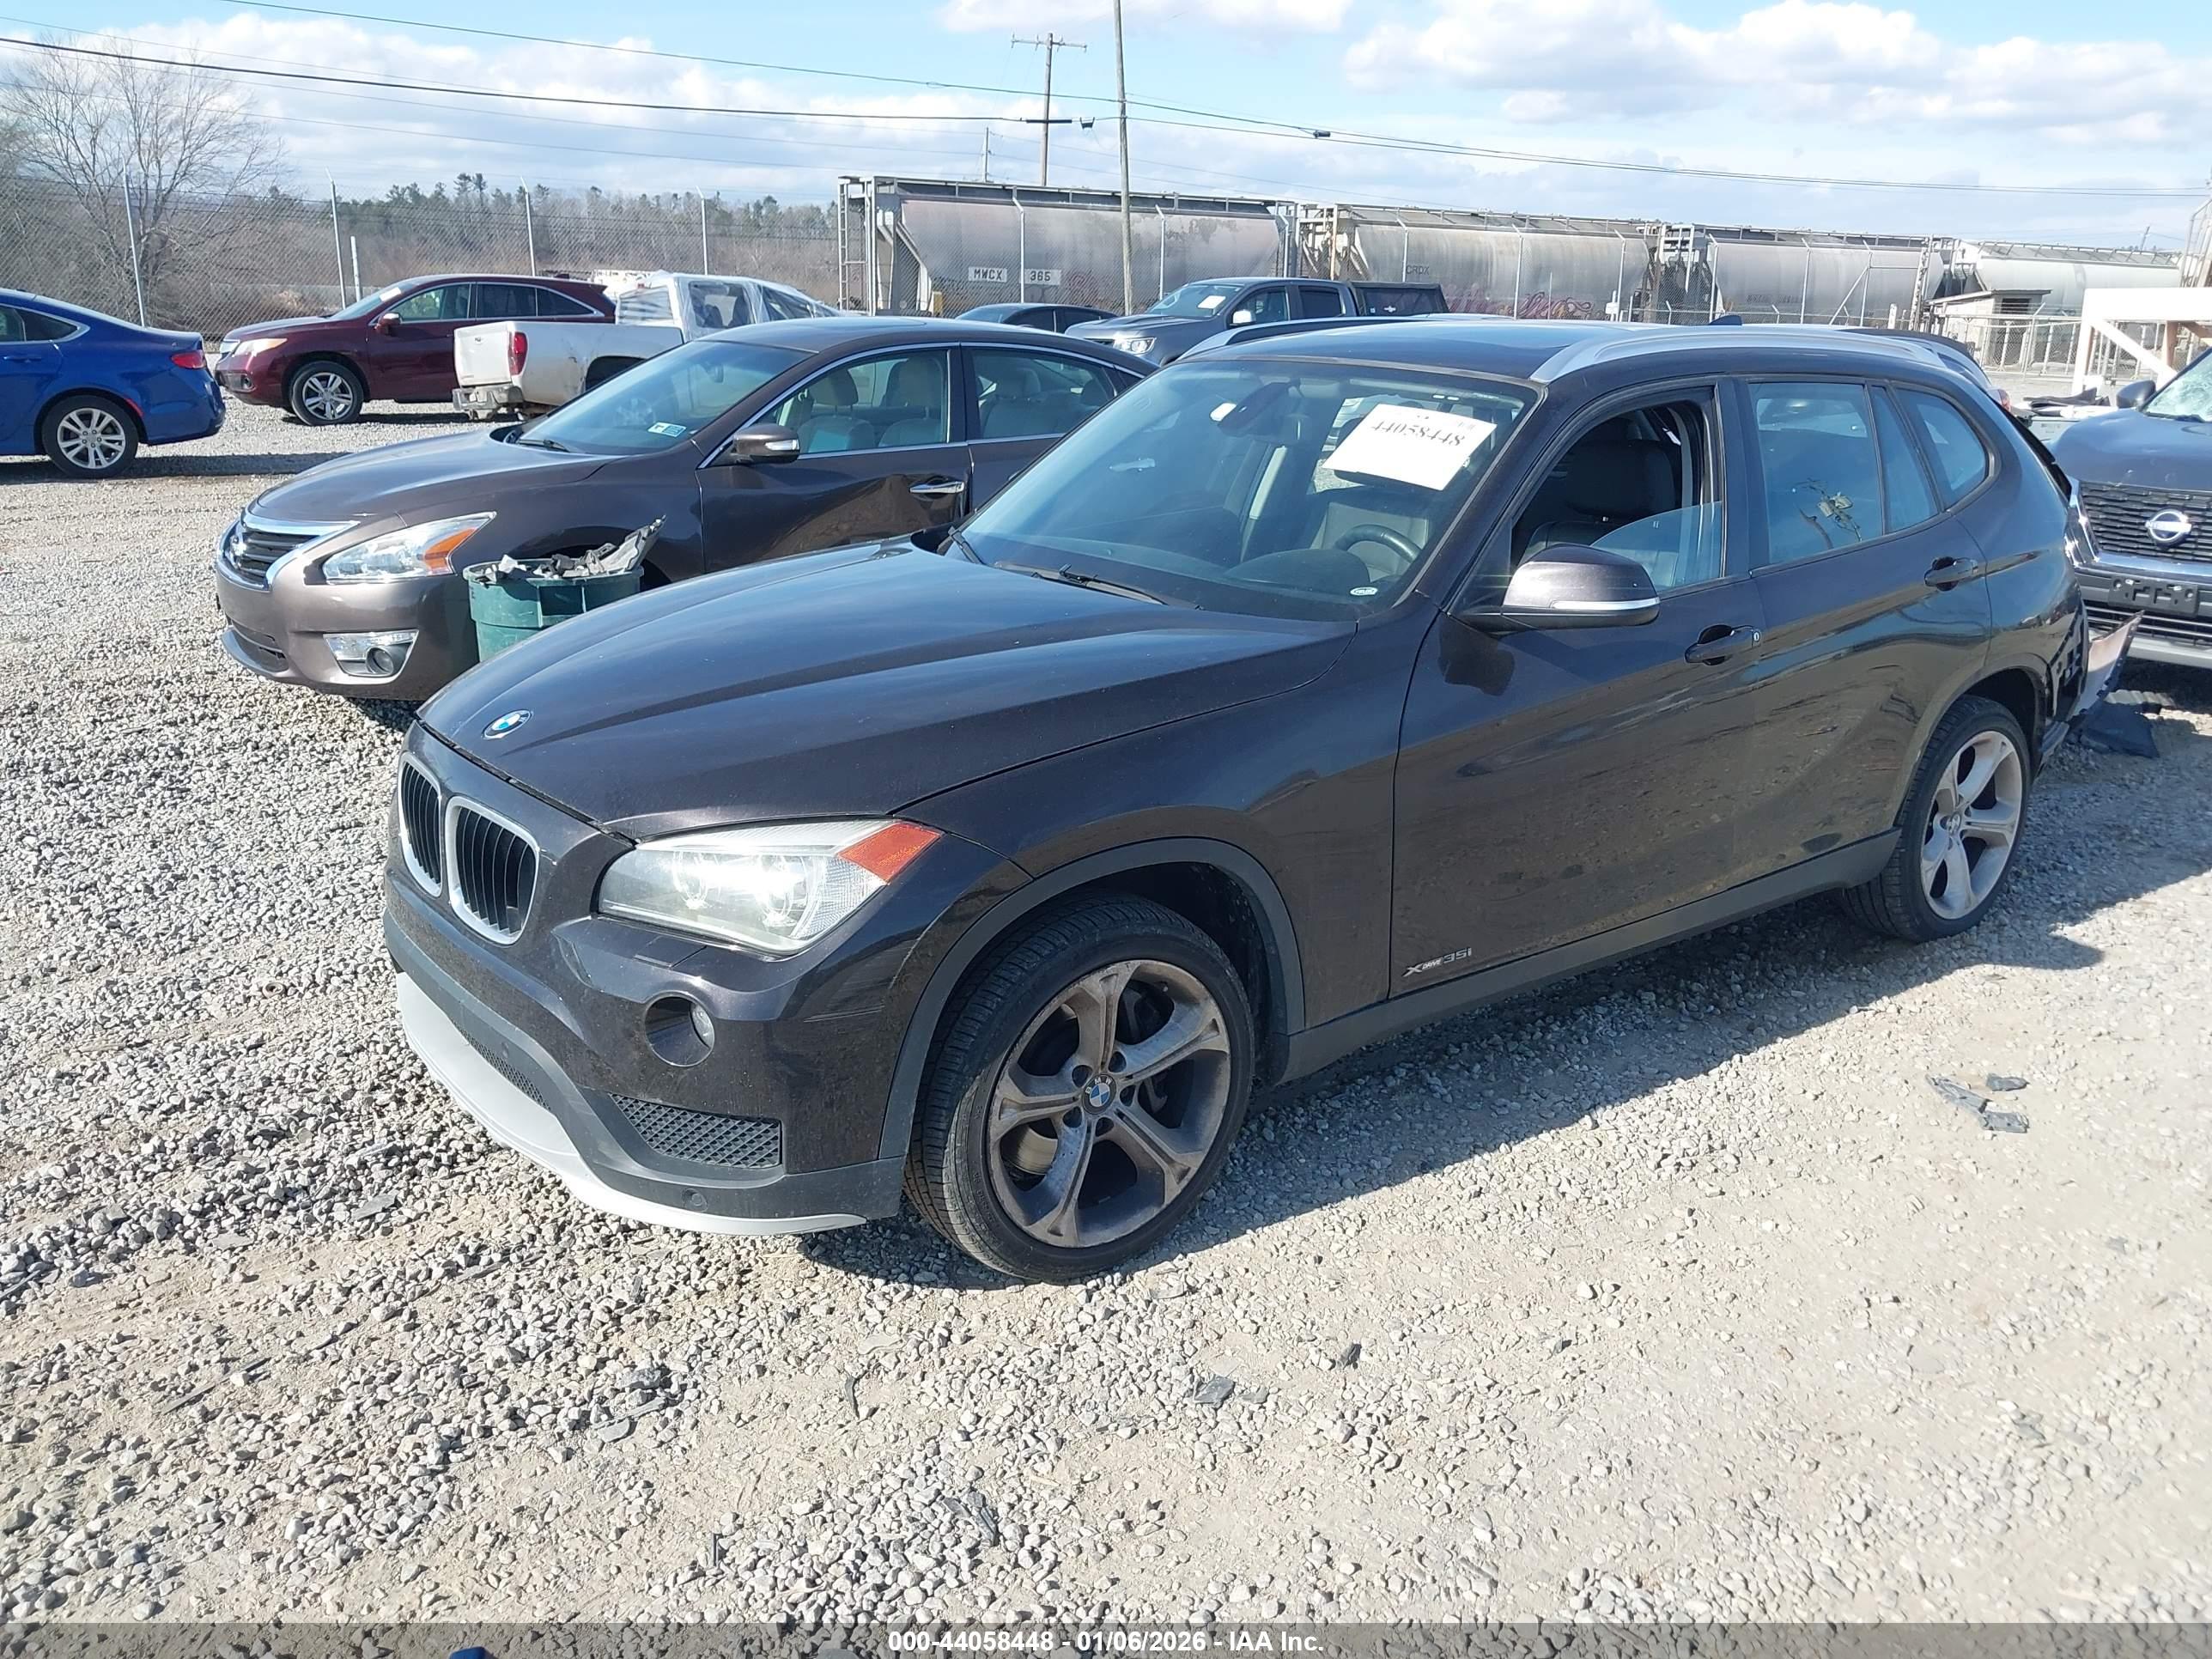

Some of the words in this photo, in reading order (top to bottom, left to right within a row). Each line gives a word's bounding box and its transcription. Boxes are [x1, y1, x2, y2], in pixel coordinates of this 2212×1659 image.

[973, 269, 1003, 281] MWCX
[1030, 270, 1051, 282] 365
[1370, 420, 1466, 447] 44058448
